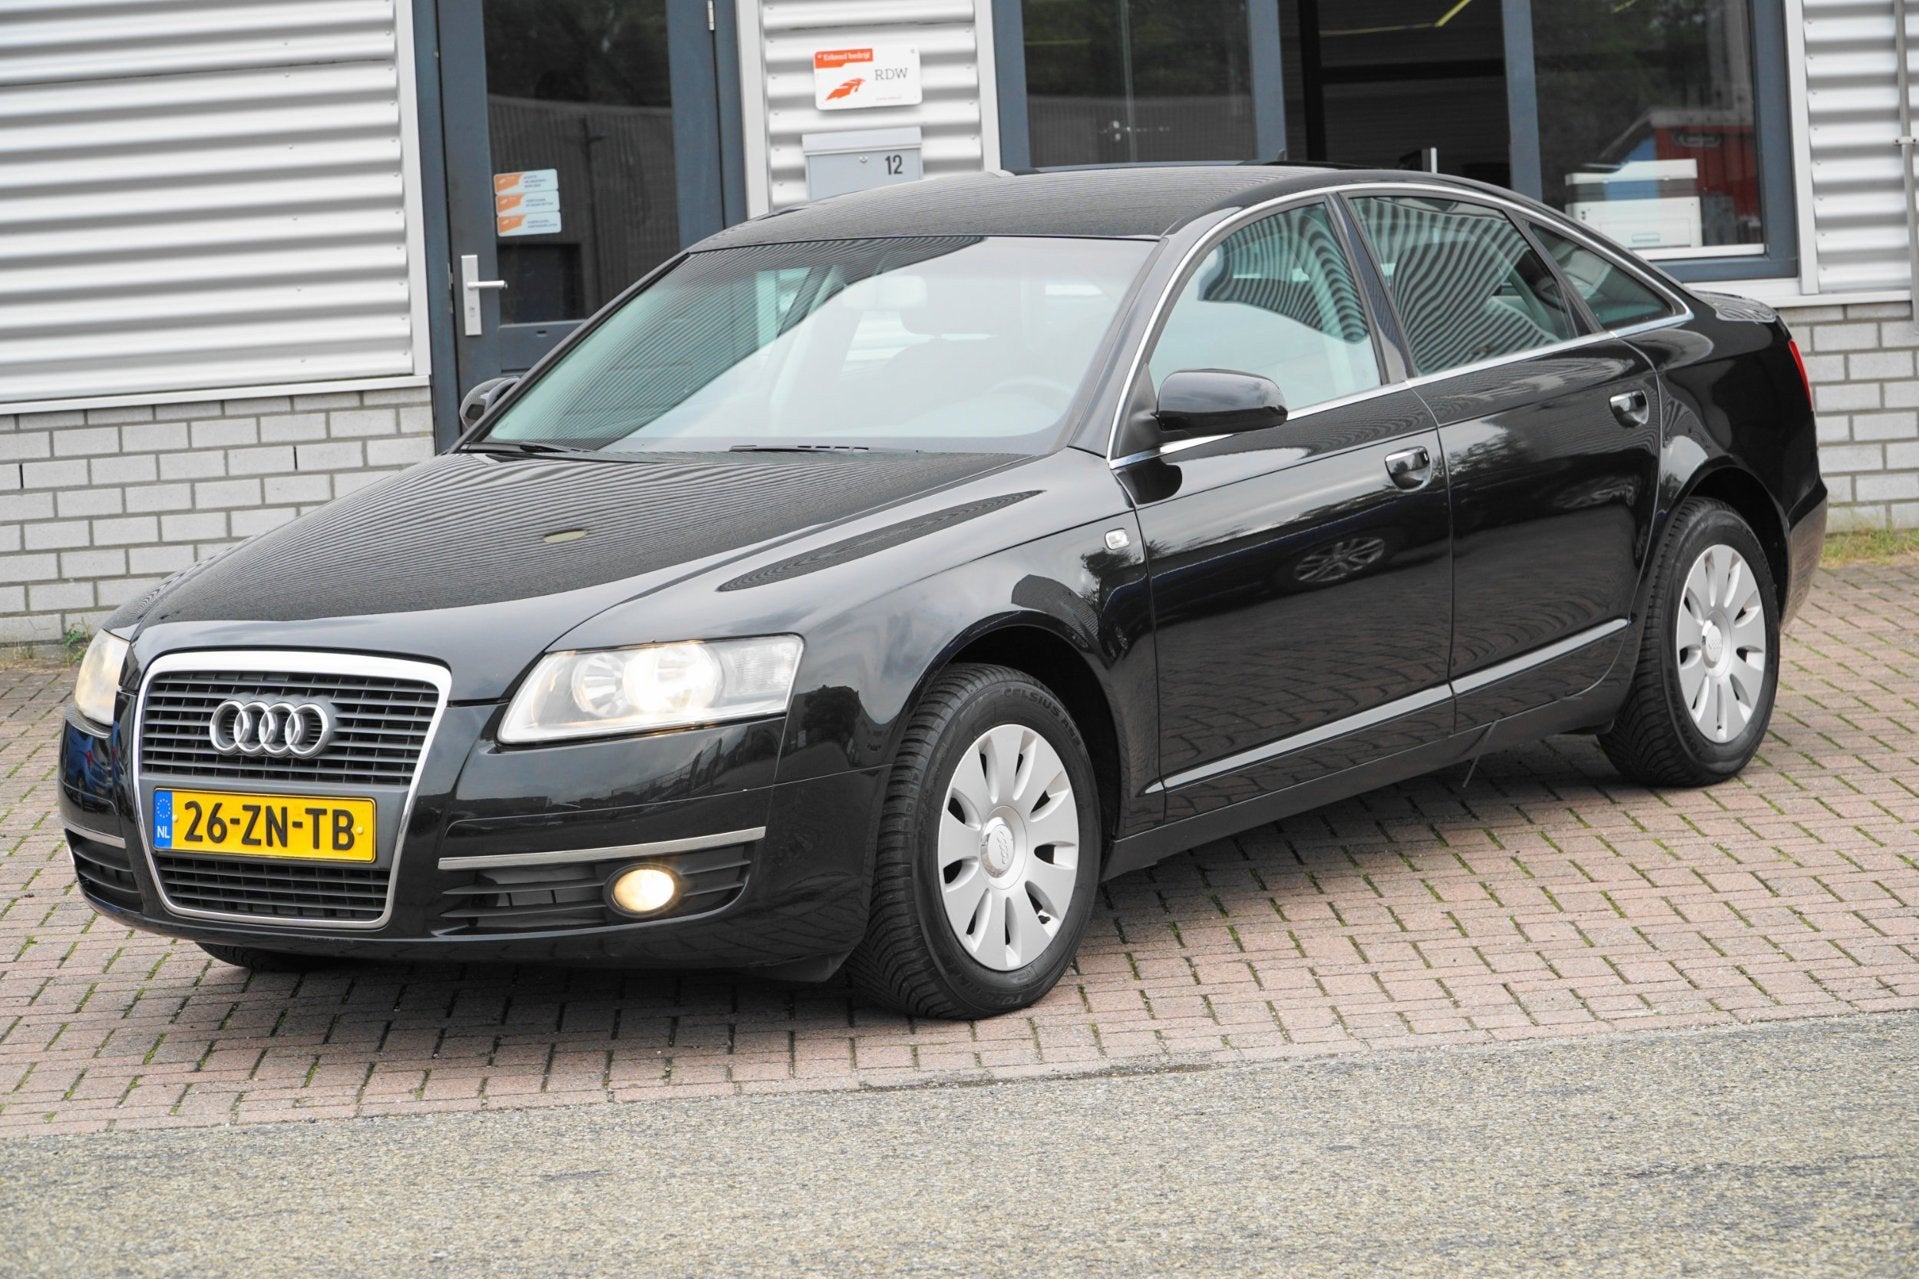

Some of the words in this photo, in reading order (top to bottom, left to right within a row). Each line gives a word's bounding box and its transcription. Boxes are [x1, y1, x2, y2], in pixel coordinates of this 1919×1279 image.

[874, 67, 909, 81] RDW
[885, 154, 903, 175] 12
[1003, 687, 1061, 718] CELSIUS
[156, 824, 171, 839] NL
[184, 800, 355, 850] 26-ZN-TB
